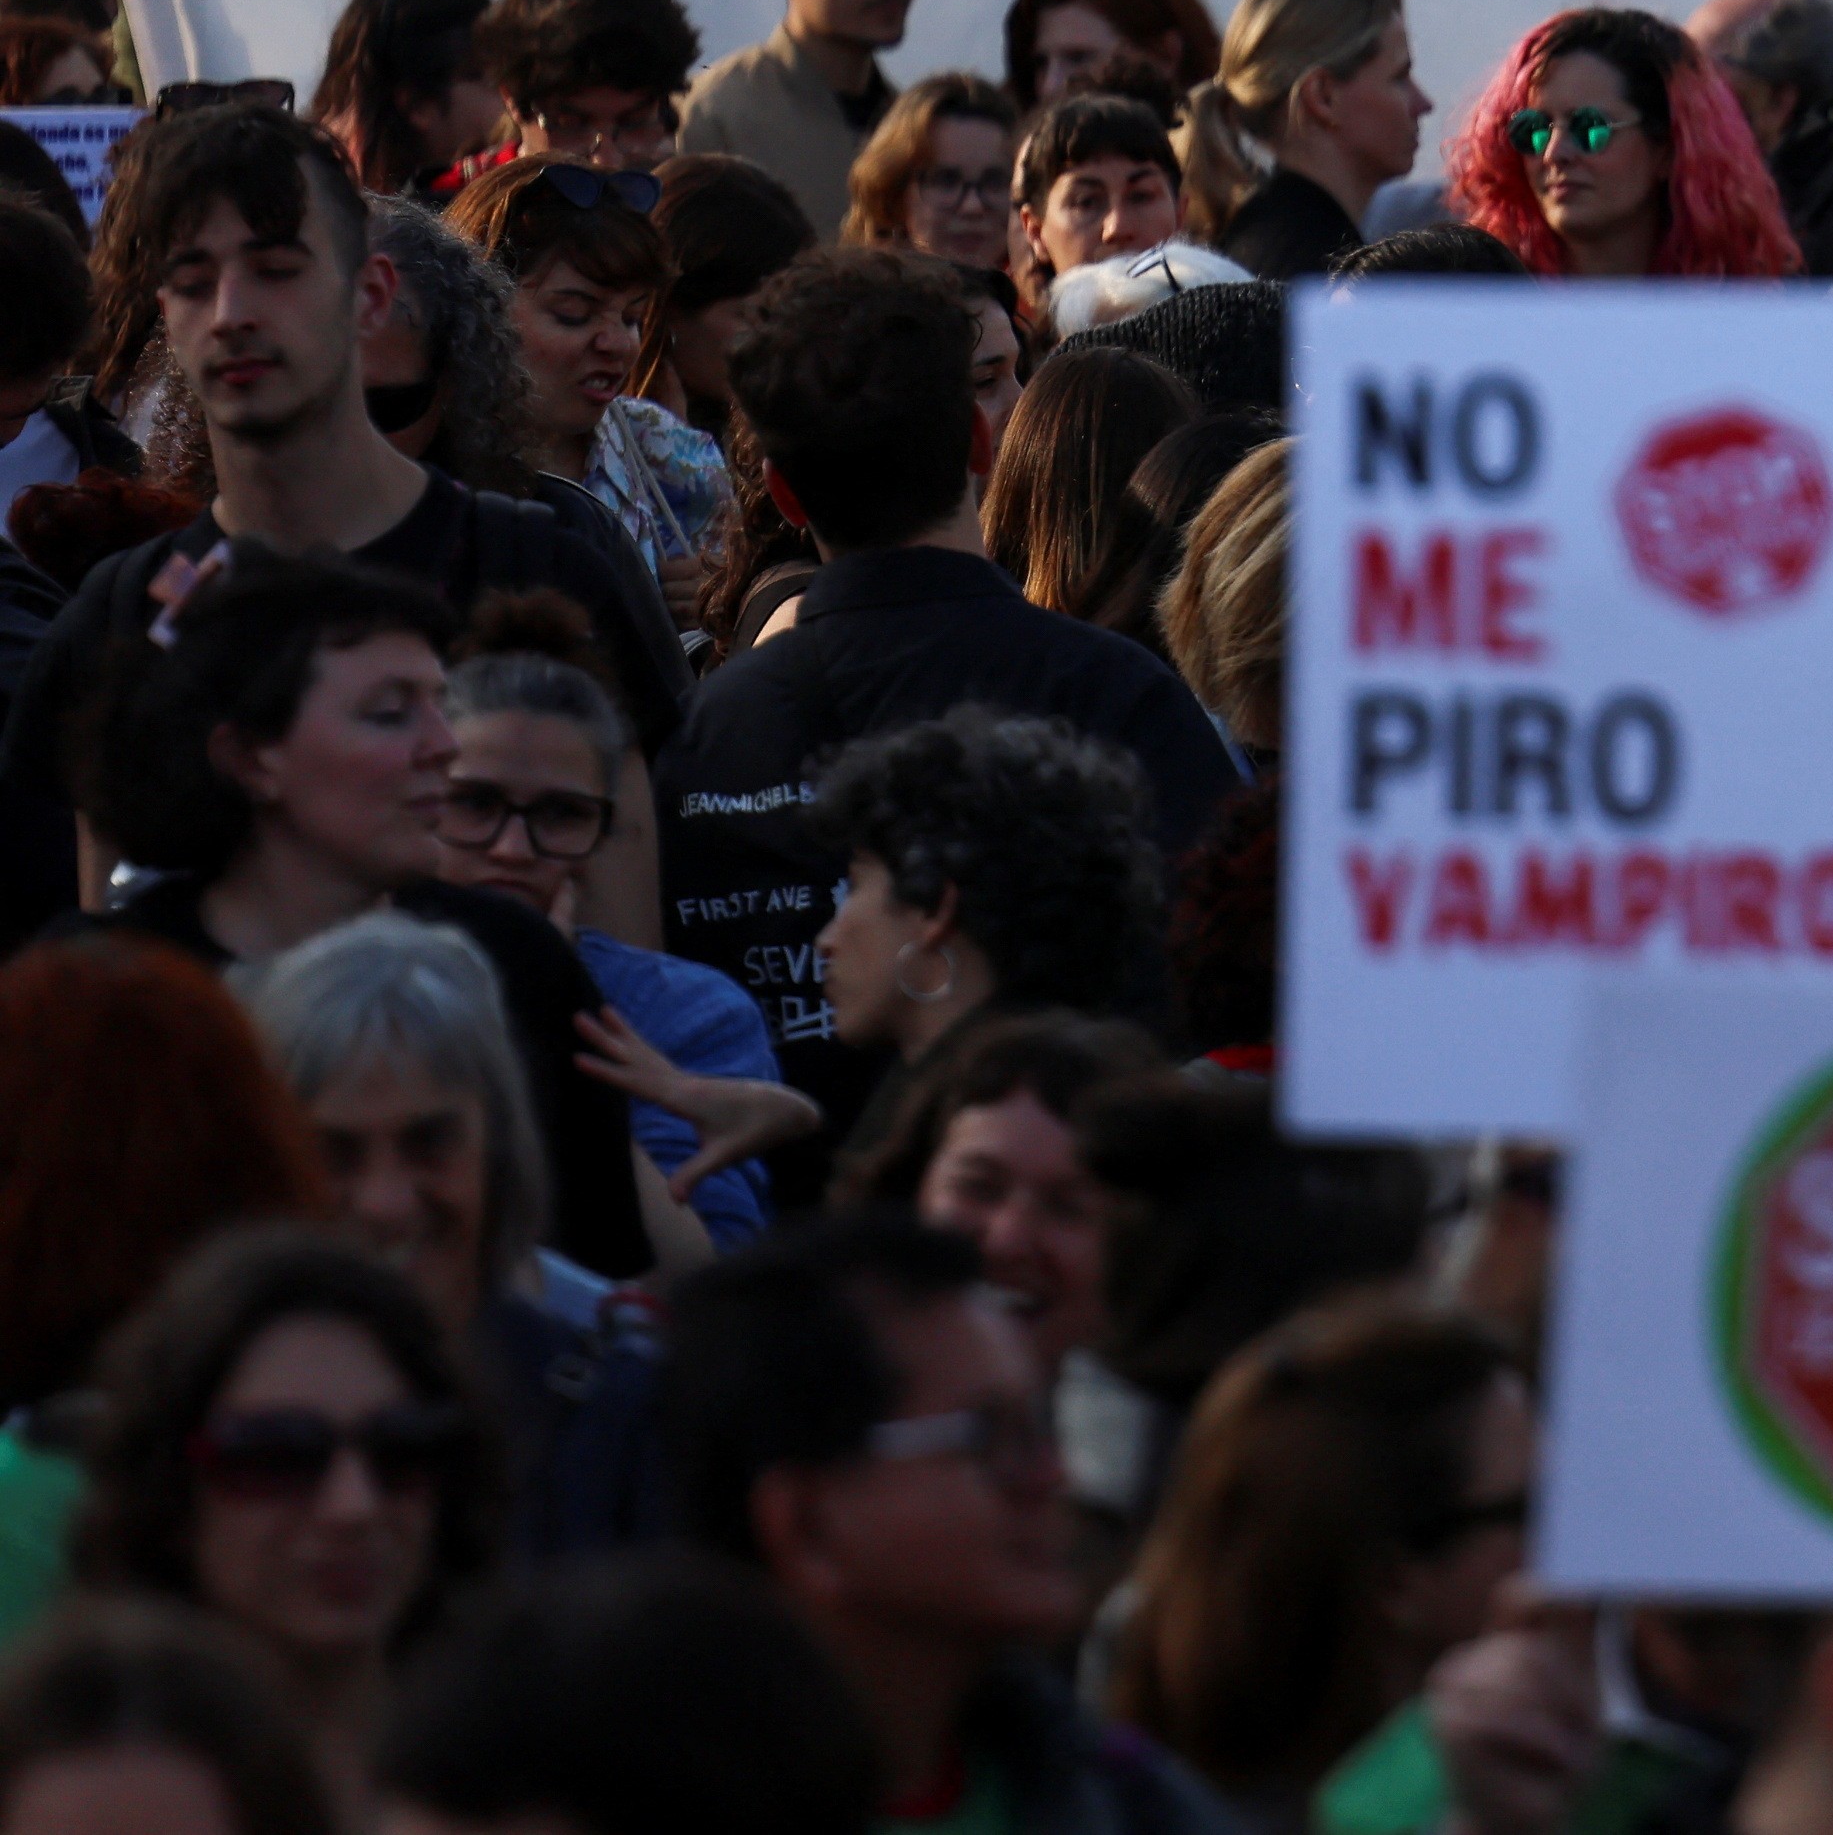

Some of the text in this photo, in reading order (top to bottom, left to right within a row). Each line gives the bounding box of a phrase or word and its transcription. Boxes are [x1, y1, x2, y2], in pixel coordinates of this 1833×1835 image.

[1346, 372, 1546, 502] NO
[1346, 525, 1550, 659] ME
[1343, 684, 1688, 832] PIRO
[677, 888, 760, 927] FIRST
